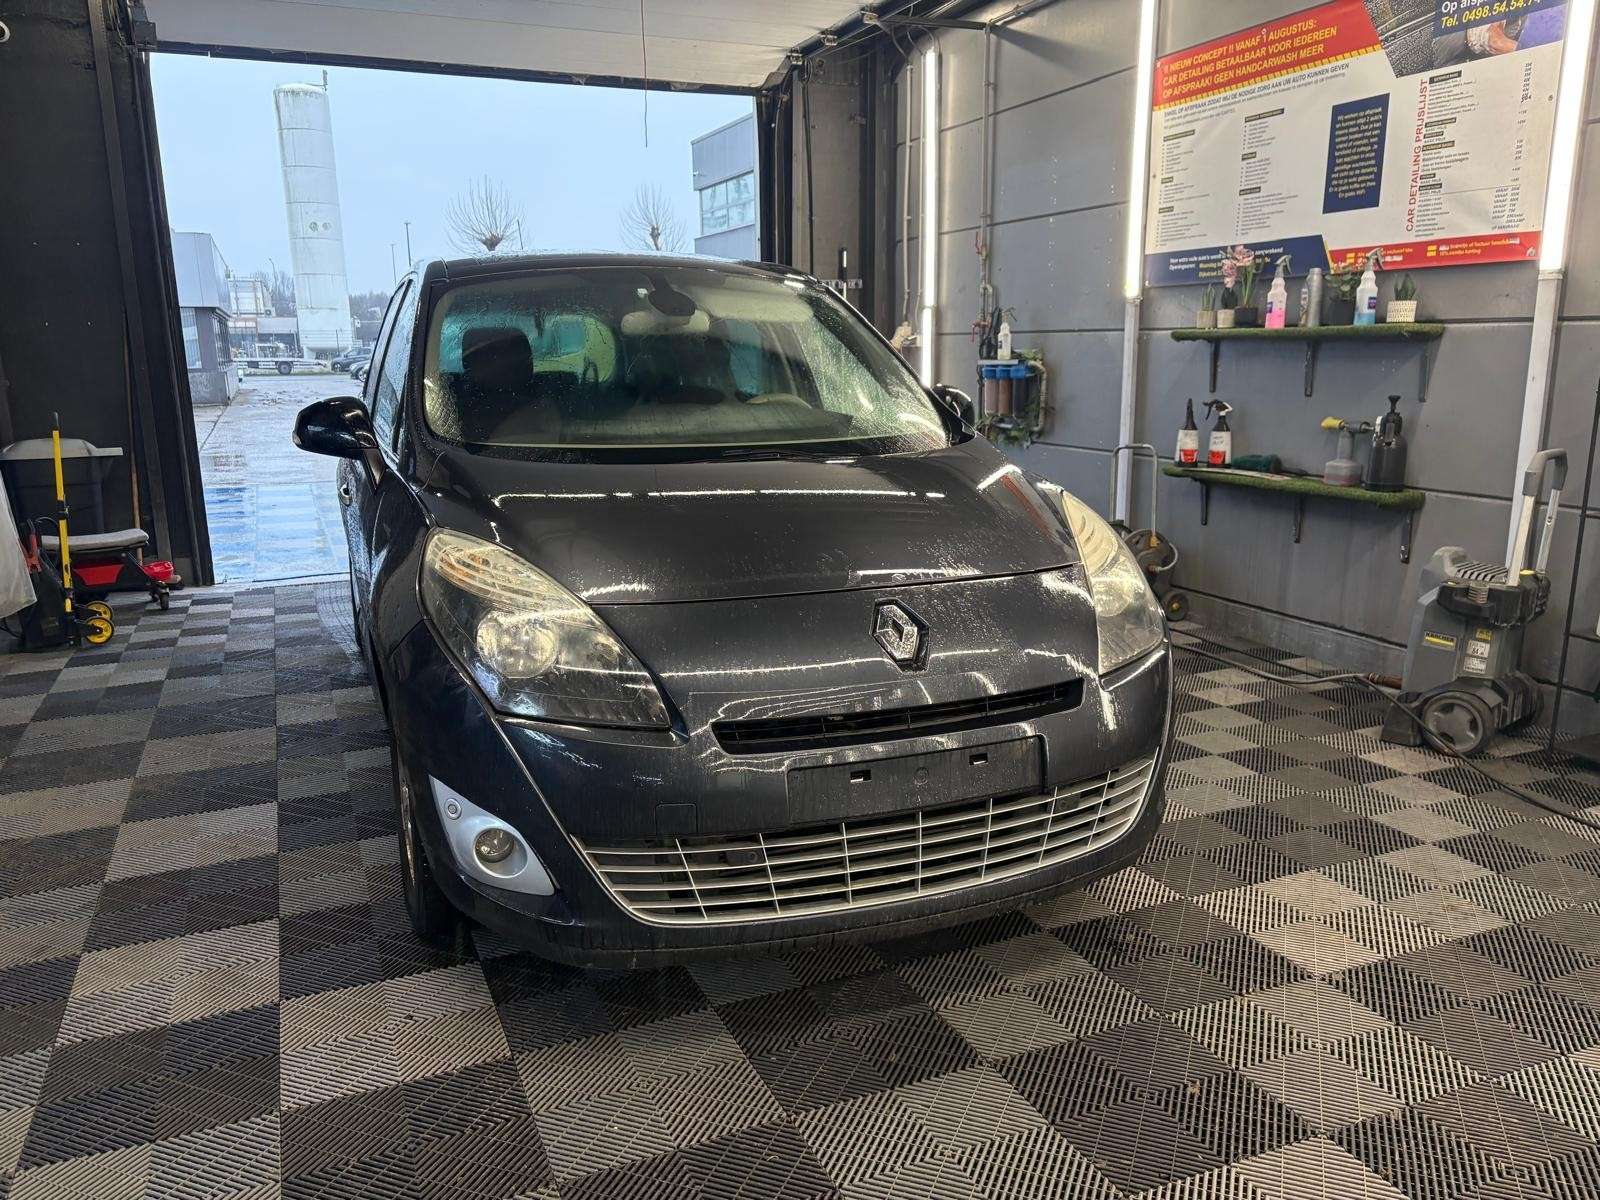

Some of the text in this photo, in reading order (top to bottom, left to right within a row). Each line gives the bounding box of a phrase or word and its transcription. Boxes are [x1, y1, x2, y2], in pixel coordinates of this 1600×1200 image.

[1441, 1, 1458, 13] Op
[1441, 14, 1458, 28] Tel.
[1163, 25, 1337, 86] CAR DETAILING BETAALBAAR VOOR IEDEREEN
[1163, 43, 1324, 98] OP AFSPRAAK! GEEN HANDCARWASH MEER
[1169, 57, 1193, 72] NIEUW
[1193, 46, 1228, 65] CONCEPT
[1235, 35, 1262, 51] VANAF
[1268, 19, 1317, 41] AUGUSTUS:
[1257, 83, 1270, 92] ZORG
[1271, 80, 1282, 88] AAN
[1283, 78, 1291, 86] UW
[1292, 74, 1307, 83] AUTO
[1306, 68, 1329, 79] KUNNEN
[1330, 63, 1350, 73] GEVEN
[1406, 80, 1427, 232] CAR DETAILING PRIJSLIJST
